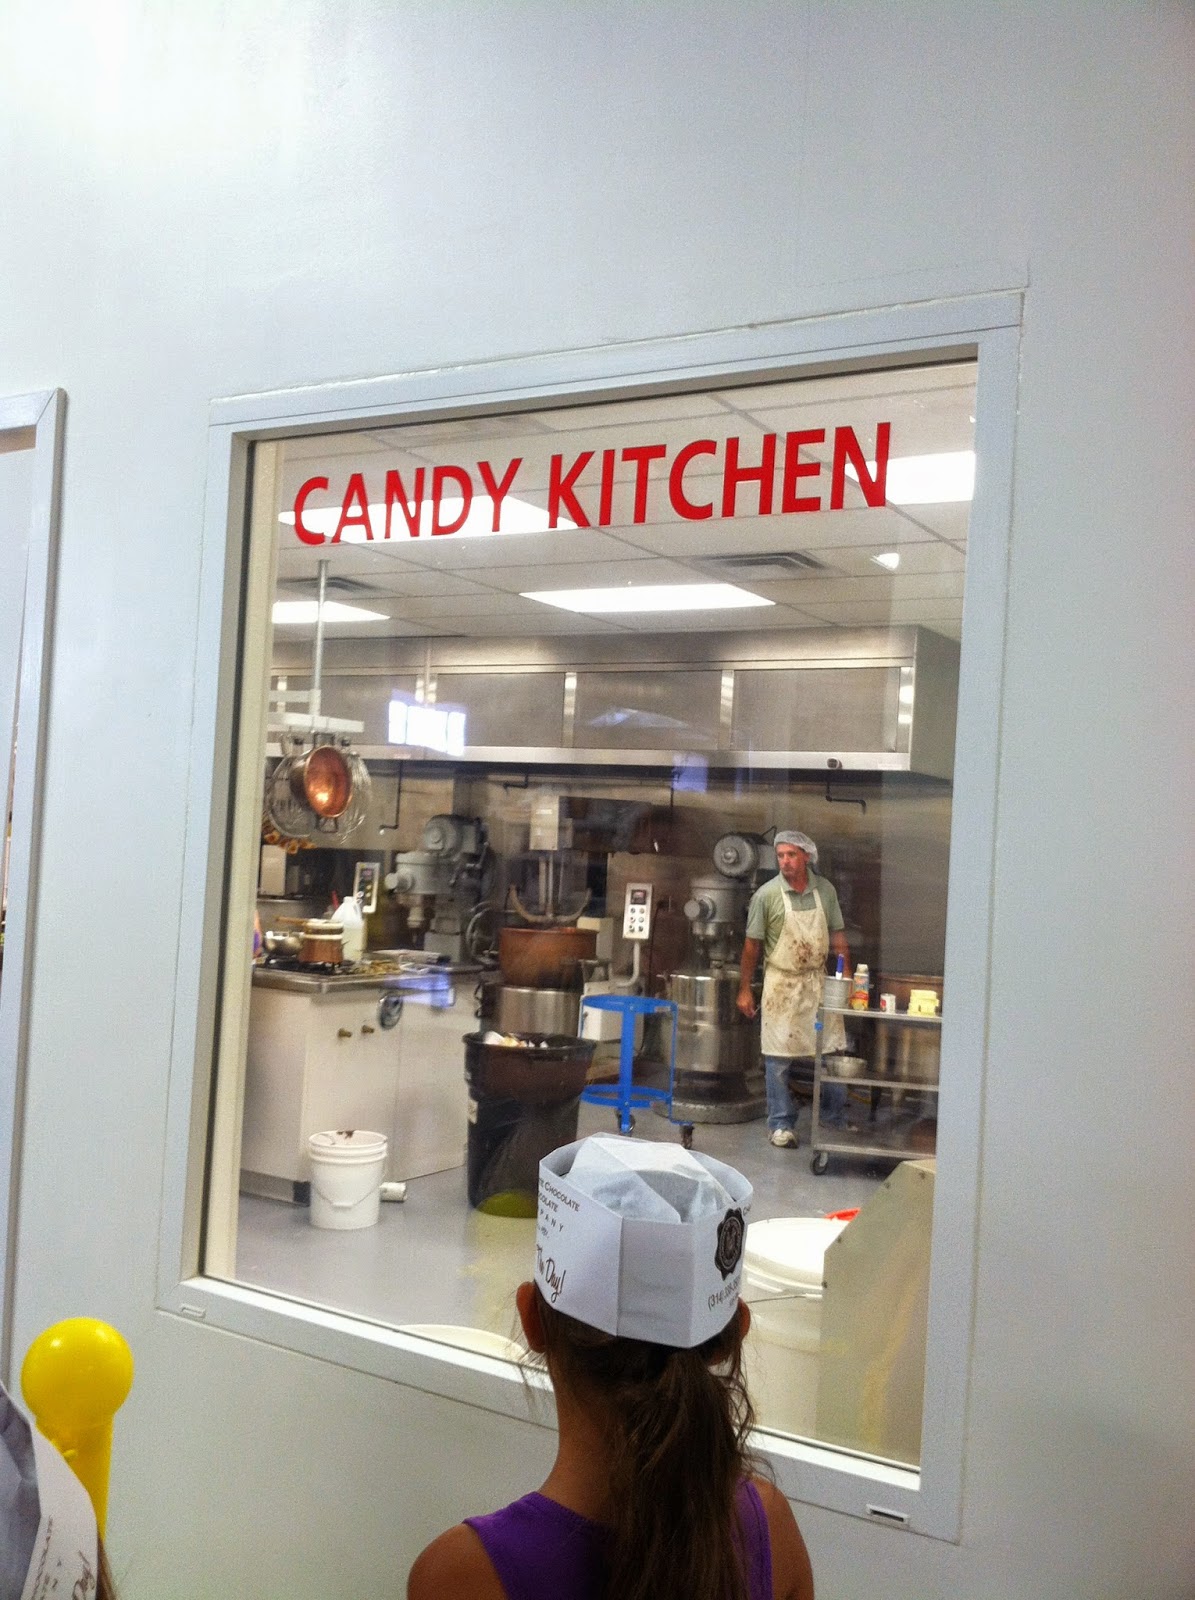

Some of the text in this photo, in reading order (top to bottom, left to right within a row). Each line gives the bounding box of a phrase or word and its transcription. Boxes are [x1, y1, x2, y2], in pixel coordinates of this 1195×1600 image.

[293, 422, 892, 546] CANDY KITCHEN
[544, 1181, 580, 1212] CHOCOLATE
